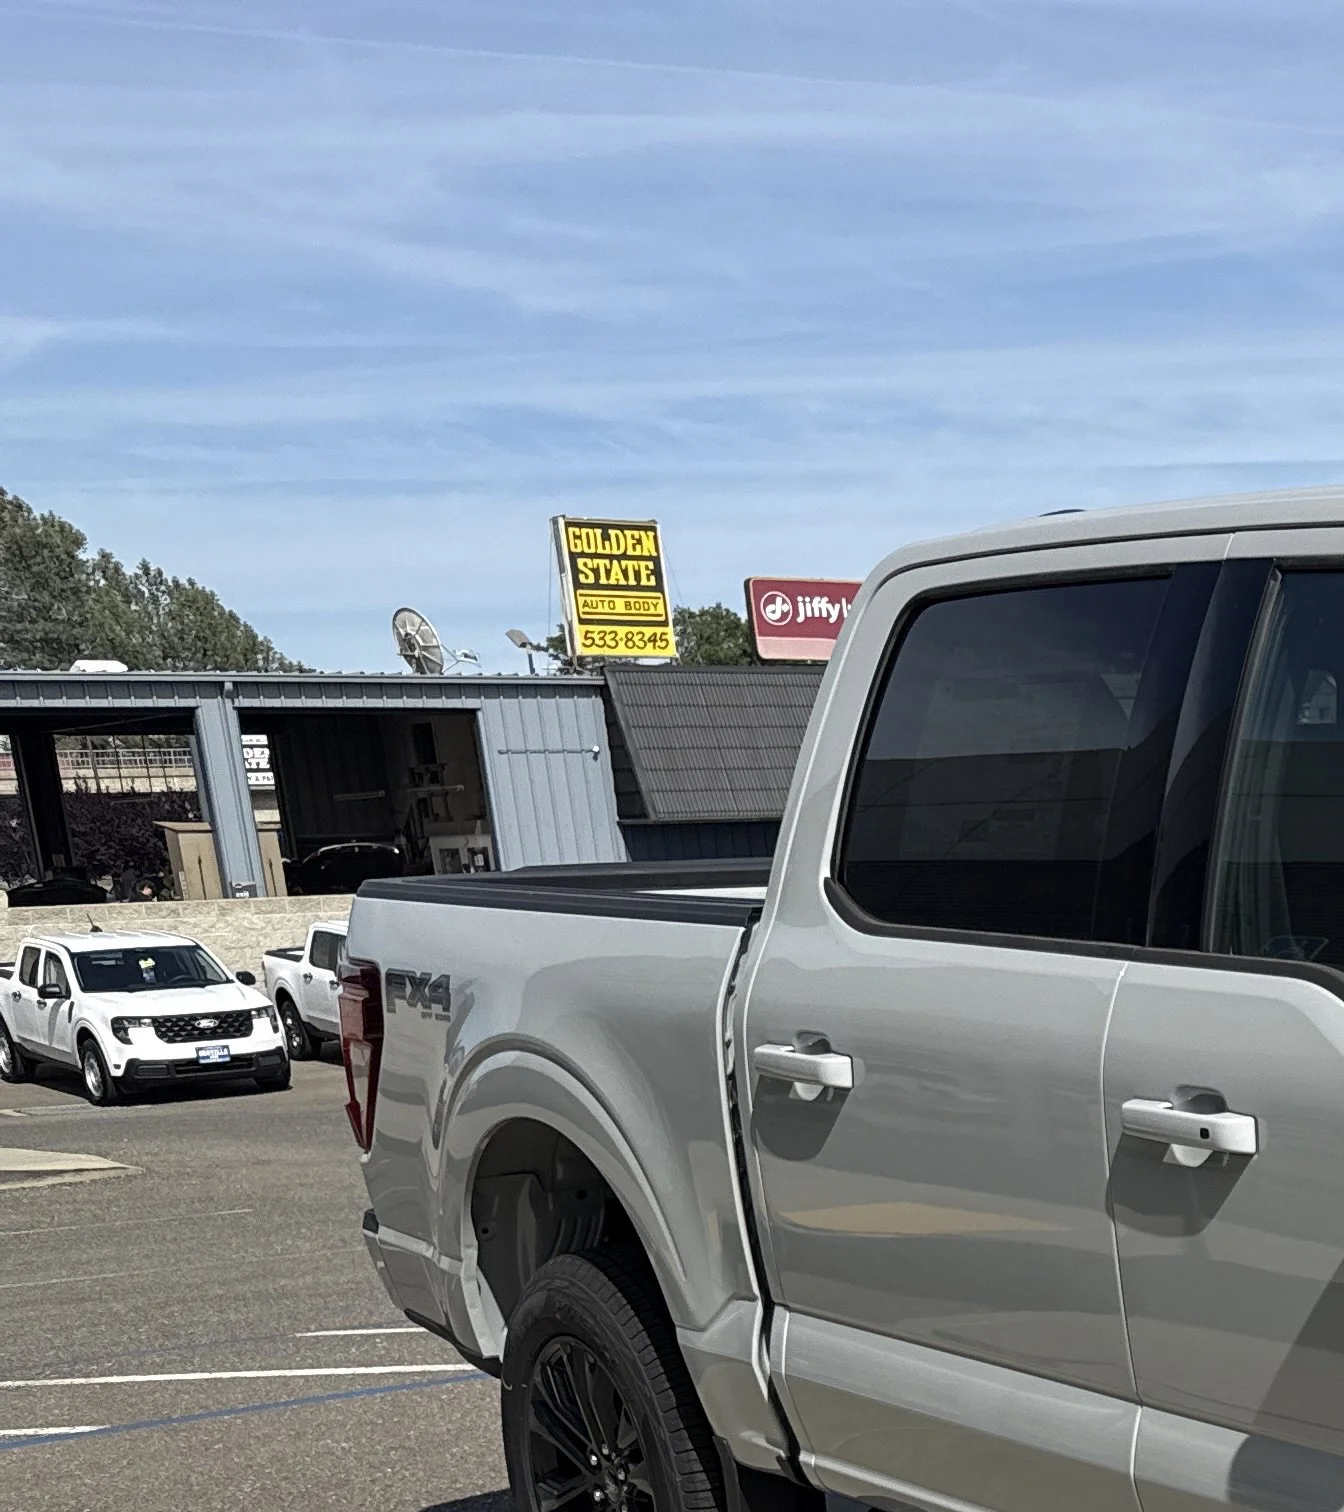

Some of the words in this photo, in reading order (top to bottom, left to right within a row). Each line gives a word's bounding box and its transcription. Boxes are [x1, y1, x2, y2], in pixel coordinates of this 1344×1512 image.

[567, 526, 658, 557] GOLDEN
[576, 557, 657, 587] STATE
[581, 599, 617, 611] AUTO
[624, 600, 660, 612] BODY
[795, 596, 841, 624] jiffy
[385, 967, 452, 1014] FX4
